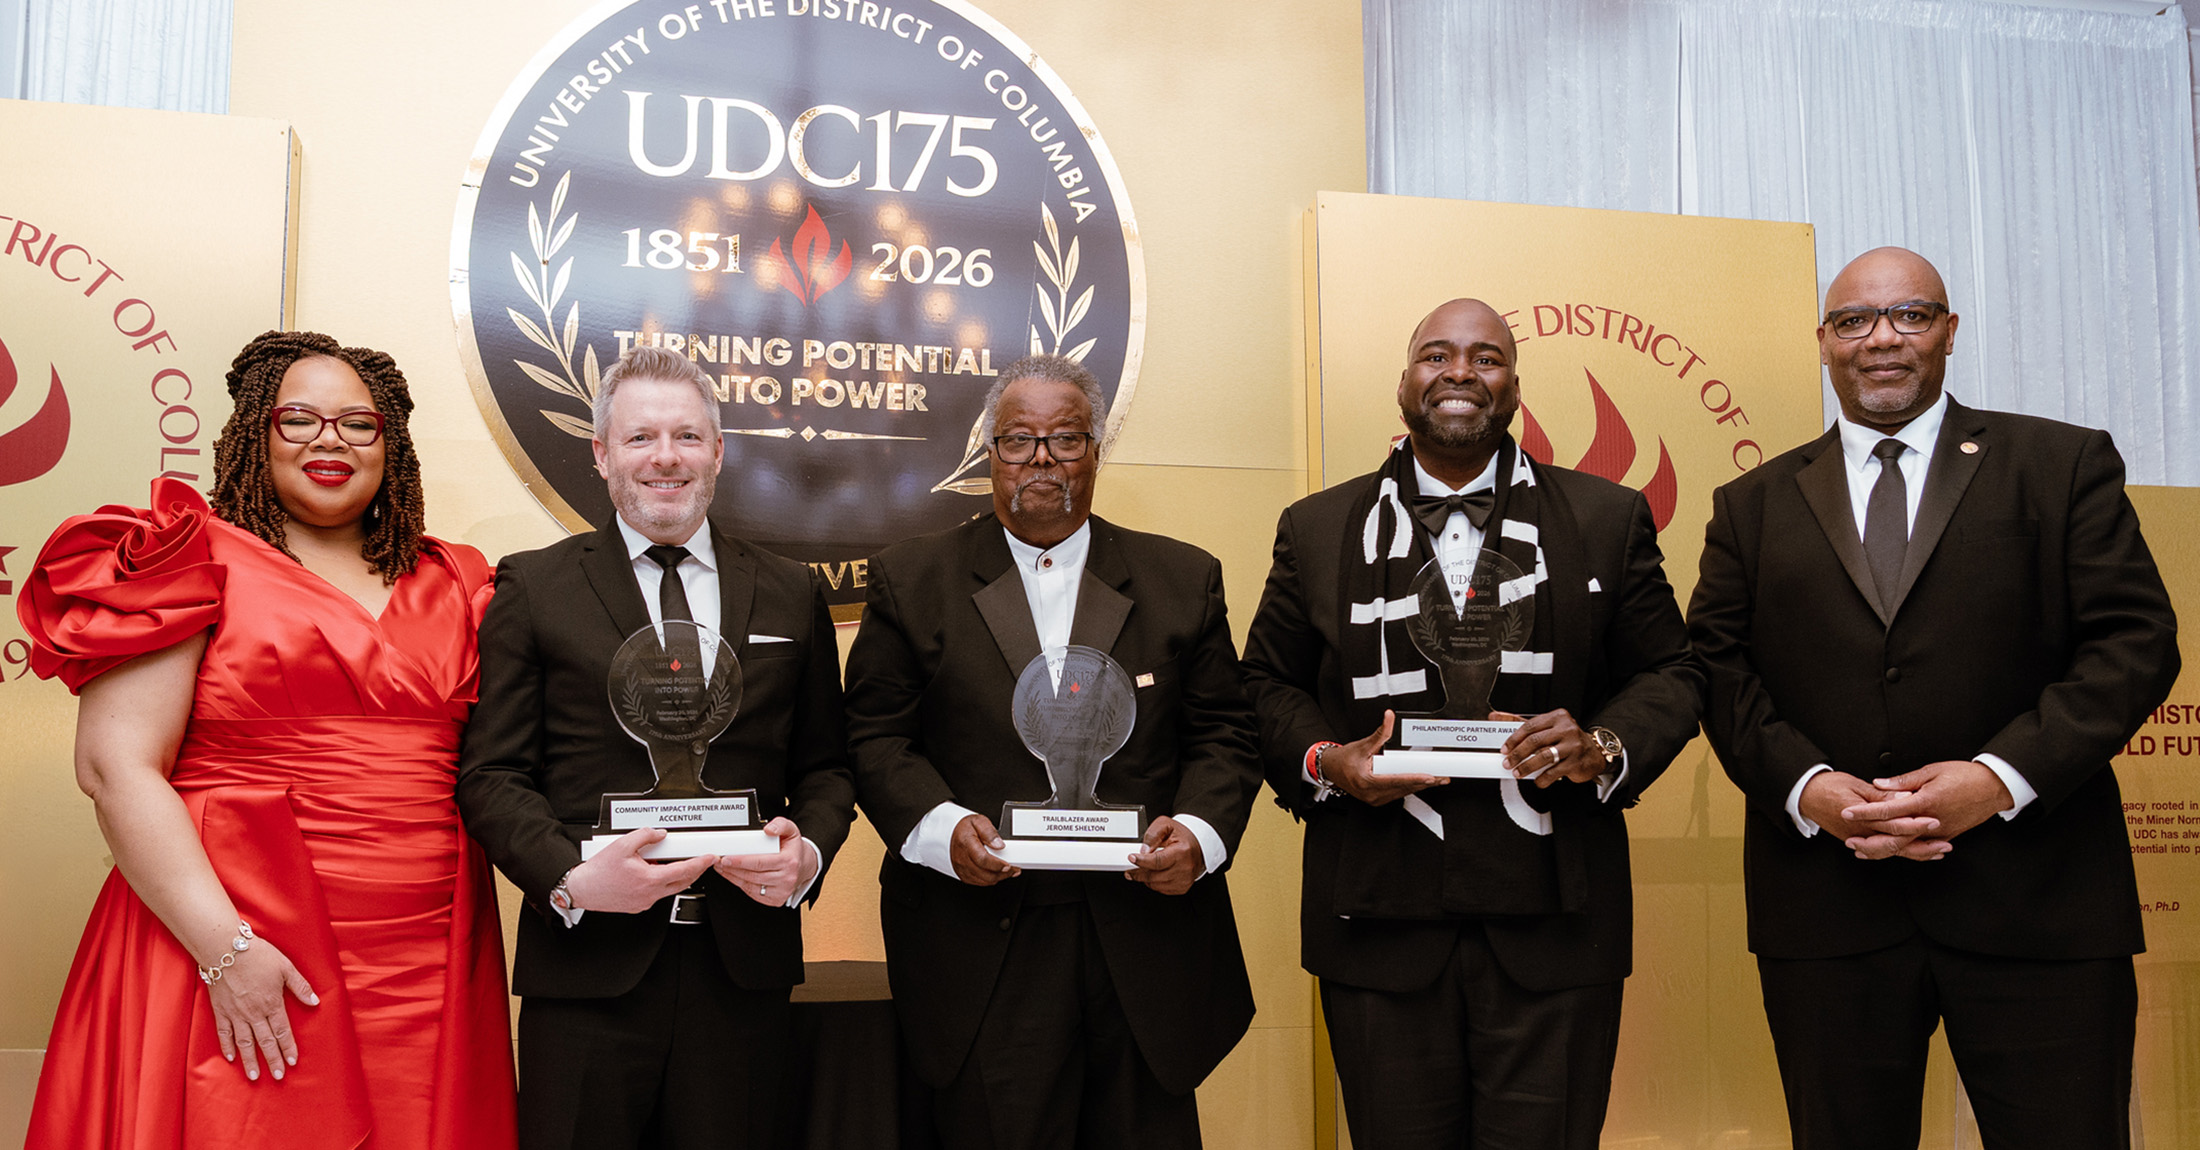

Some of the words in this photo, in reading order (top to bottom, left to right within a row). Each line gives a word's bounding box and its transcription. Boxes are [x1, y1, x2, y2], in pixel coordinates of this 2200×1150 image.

[509, 27, 650, 188] UNIVERSITY
[658, 5, 703, 40] OF
[710, 0, 776, 24] THE
[787, 0, 934, 45] DISTRICT
[937, 35, 984, 71] OF
[984, 69, 1098, 225] COLUMBIA
[621, 90, 999, 197] UDC175
[621, 227, 745, 274] 1851
[869, 242, 995, 288] 2026
[113, 298, 178, 354] OF
[803, 339, 999, 377] POTENTIAL
[1533, 303, 1707, 380] DISTRICT
[1700, 379, 1750, 428] OF
[705, 374, 782, 406] NTO
[792, 378, 929, 412] POWER
[1412, 725, 1465, 733] PHILANTHROPIC
[2116, 736, 2156, 756] LD
[615, 806, 659, 814] COMMUNITY
[2122, 802, 2146, 812] gacy
[2151, 801, 2184, 810] rooted
[2189, 800, 2198, 810] in
[659, 814, 702, 822] ACCENTURE
[2127, 815, 2143, 825] the
[2146, 815, 2175, 825] Miner
[2133, 829, 2157, 839] UDC
[2160, 829, 2179, 839] has
[2130, 844, 2167, 854] otential
[2171, 844, 2190, 853] into
